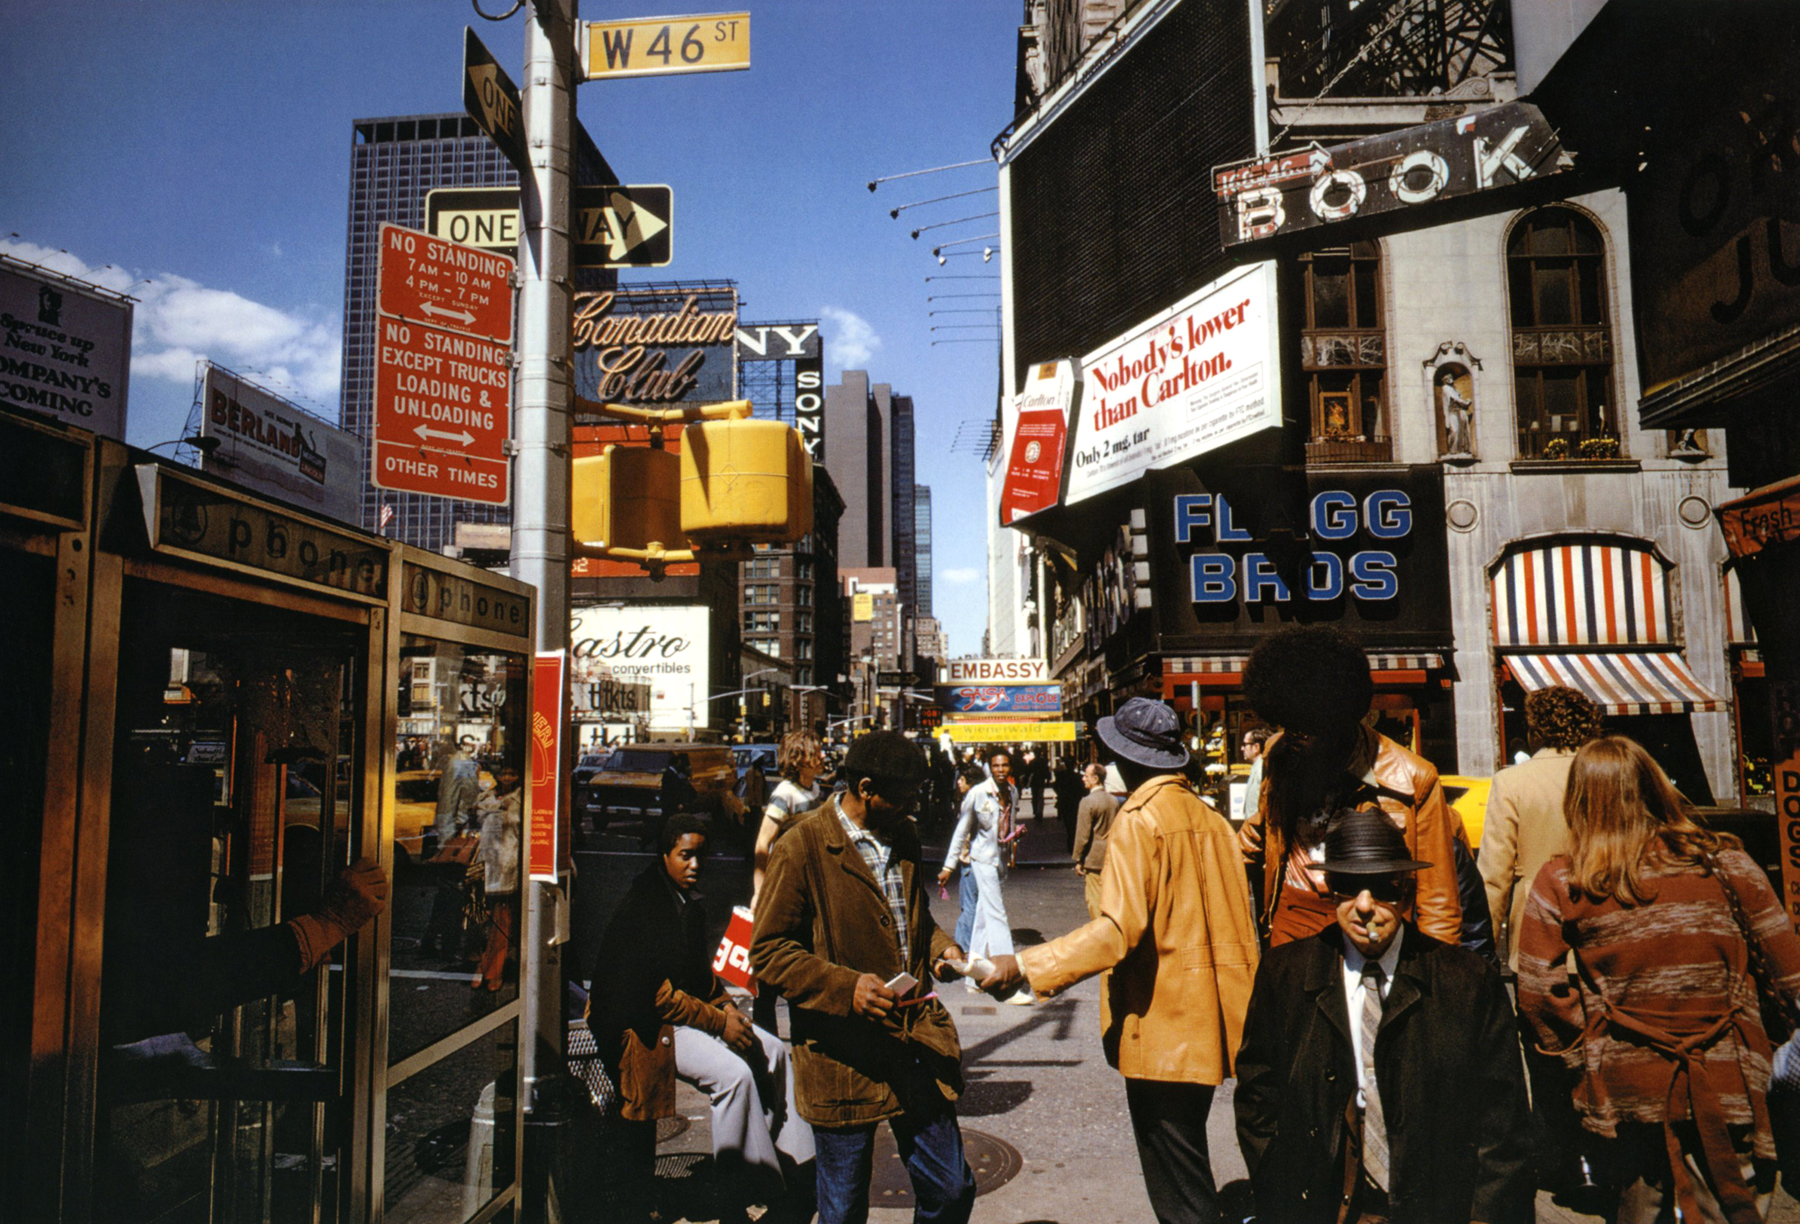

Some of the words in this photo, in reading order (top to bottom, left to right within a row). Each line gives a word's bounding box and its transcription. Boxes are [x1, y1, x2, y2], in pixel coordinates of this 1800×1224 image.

[603, 29, 633, 69] W
[646, 24, 705, 65] 46
[715, 21, 740, 42] ST
[484, 77, 515, 136] ONE
[1237, 124, 1536, 242] BOOK
[450, 214, 516, 243] ONE
[391, 232, 416, 254] NO
[427, 243, 506, 278] STANDING
[408, 258, 416, 271] 7
[419, 263, 438, 276] AM
[456, 271, 468, 285] 10
[472, 278, 491, 290] AM
[406, 275, 414, 288] 4
[420, 280, 438, 293] PM
[458, 287, 465, 299] 7
[470, 293, 489, 305] PM
[419, 292, 445, 302] EXCEPT
[452, 300, 478, 310] SUNDAY
[1, 313, 67, 343] Spruce
[71, 336, 94, 353] up
[574, 292, 737, 346] Canadian
[4, 332, 46, 355] New
[50, 344, 88, 368] York
[386, 323, 410, 344] NO
[424, 332, 505, 366] STANDING
[1092, 326, 1183, 400] Nobody's
[1187, 299, 1250, 353] lower
[382, 347, 443, 374] EXCEPT
[449, 360, 506, 388] TRUCKS
[598, 346, 704, 400] Club
[397, 373, 471, 403] LOADING
[480, 390, 492, 408] &
[1093, 397, 1138, 431] than
[1141, 352, 1232, 408] Carlton.
[394, 396, 494, 430] UNLOADING
[1076, 446, 1101, 468] Only
[1103, 440, 1110, 458] 2
[1133, 428, 1150, 445] tar
[385, 456, 439, 479] OTHER
[448, 467, 498, 489] TIMES
[1741, 500, 1792, 537] Fresh
[228, 517, 376, 584] phone
[1190, 551, 1398, 603] BROS
[440, 577, 521, 624] phone
[612, 662, 691, 676] convertibles
[951, 662, 1044, 679] EMBASSY
[960, 686, 1009, 711] SALSA
[1014, 691, 1058, 704] EXPLODE
[964, 723, 1042, 734] Wienerwald
[1783, 770, 1800, 870] DOGS
